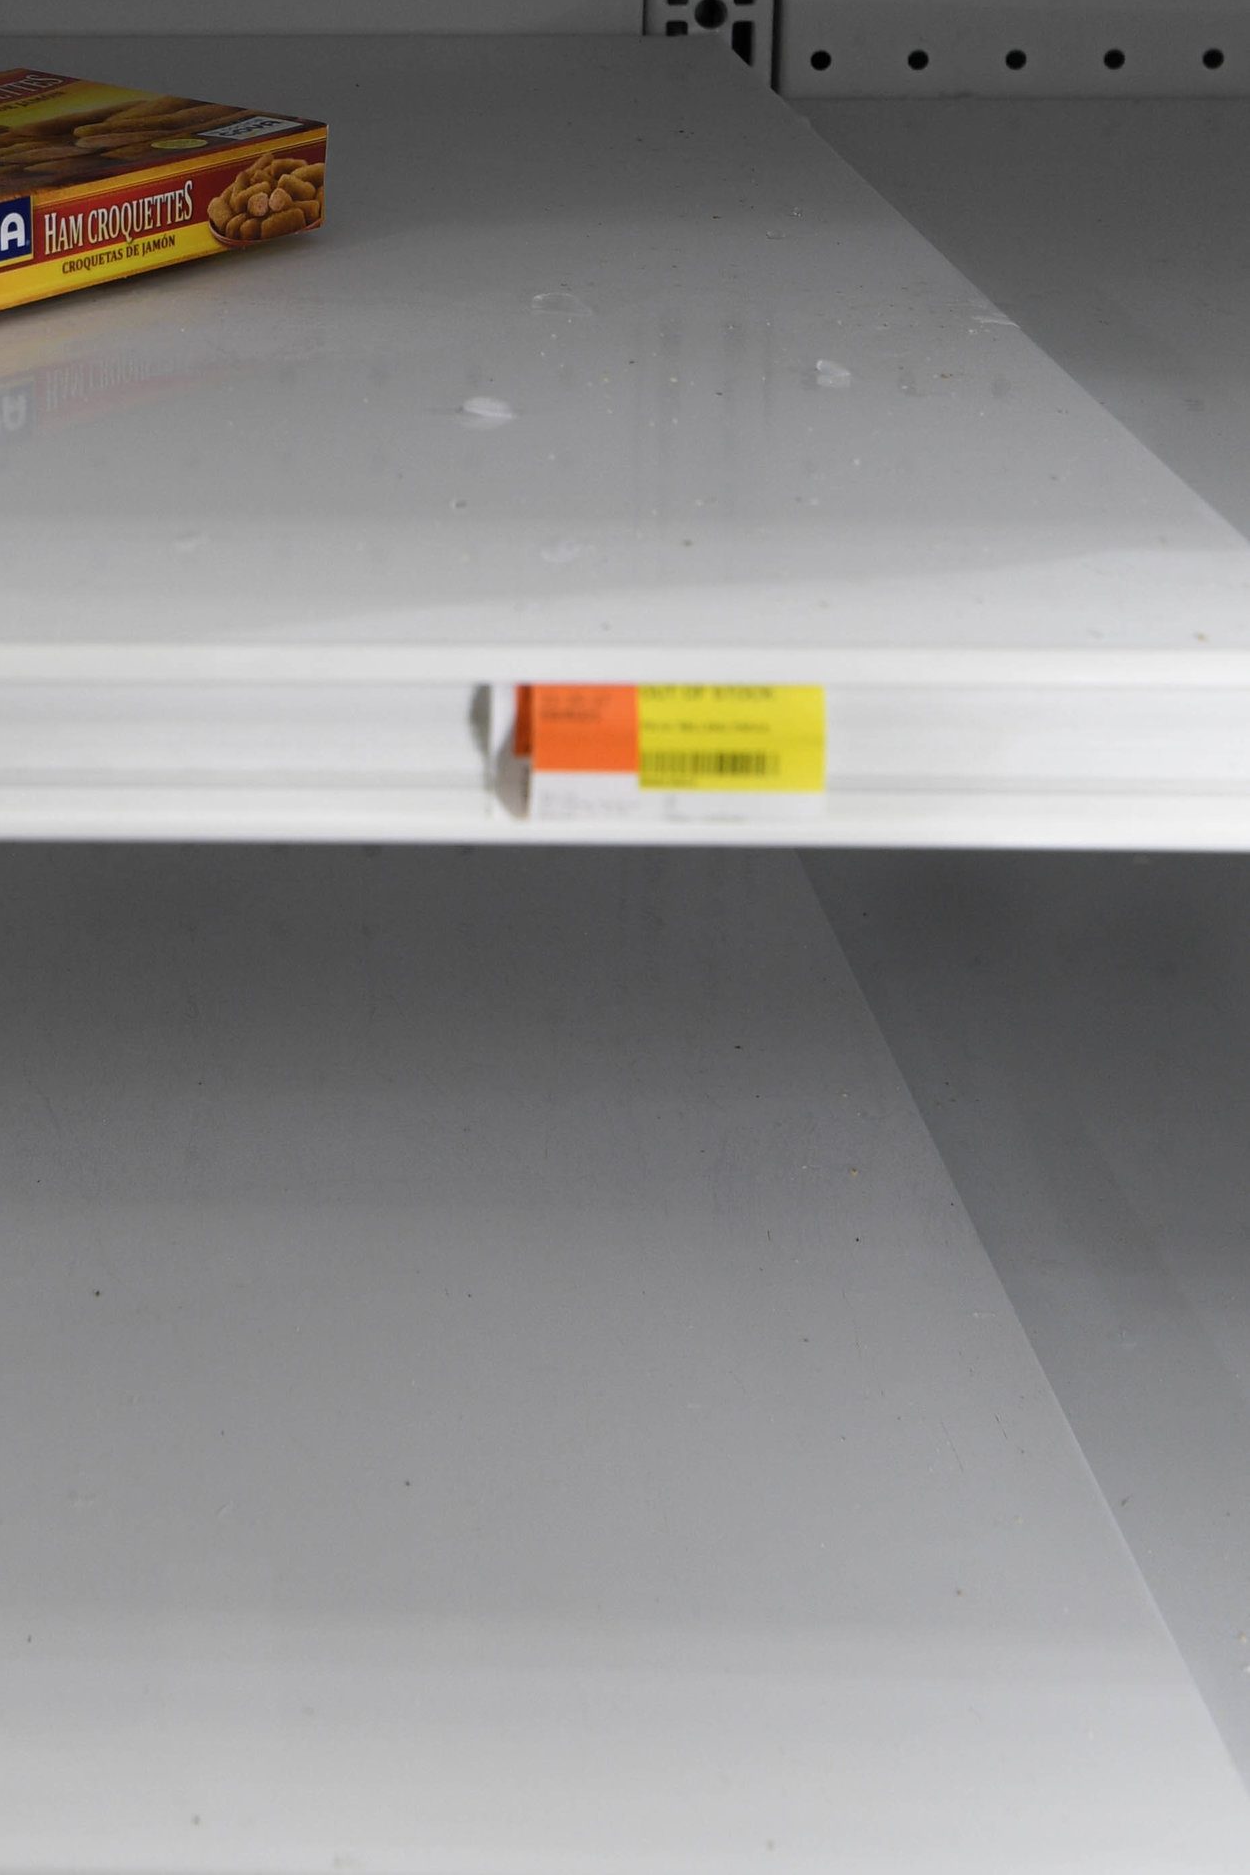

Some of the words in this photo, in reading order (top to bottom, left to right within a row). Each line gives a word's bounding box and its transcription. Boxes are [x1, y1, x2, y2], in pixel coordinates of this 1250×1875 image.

[44, 211, 84, 256] HAM
[87, 179, 194, 245] CROQUETTES
[62, 248, 124, 275] CROQUETAS
[126, 243, 140, 258] DE
[141, 233, 176, 259] JAMÓN
